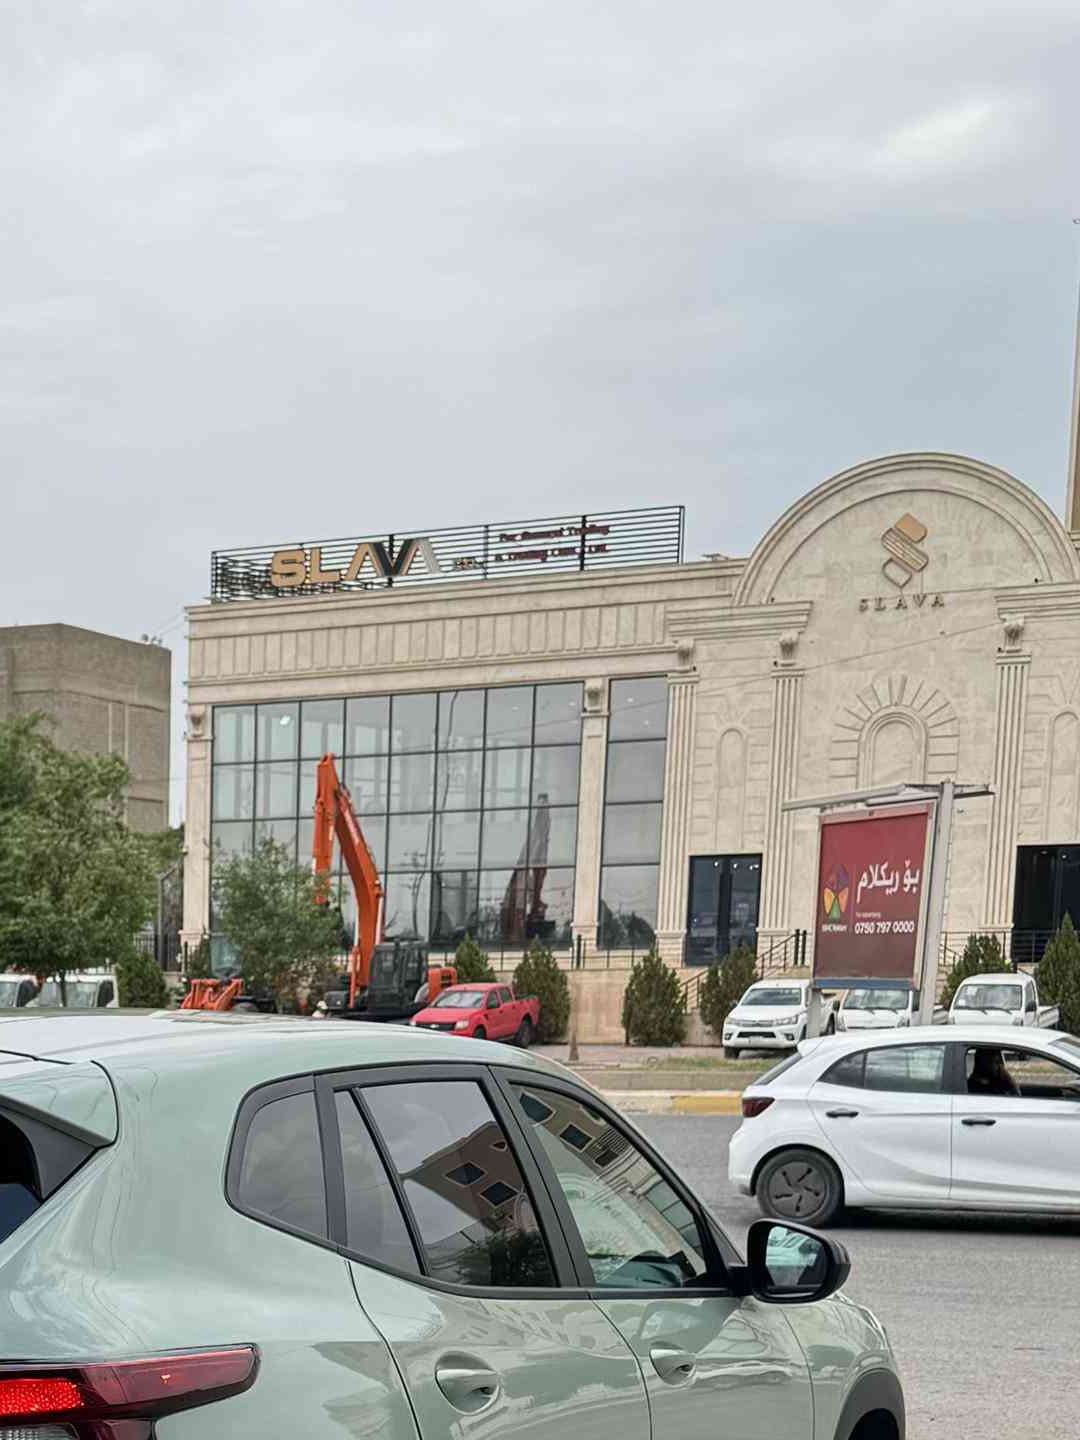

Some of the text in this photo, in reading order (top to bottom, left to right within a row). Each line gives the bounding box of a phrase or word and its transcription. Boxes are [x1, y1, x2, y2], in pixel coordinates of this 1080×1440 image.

[270, 537, 441, 588] SLAVA
[859, 592, 945, 612] SLAVA
[854, 920, 915, 935] 0750 797 0000
